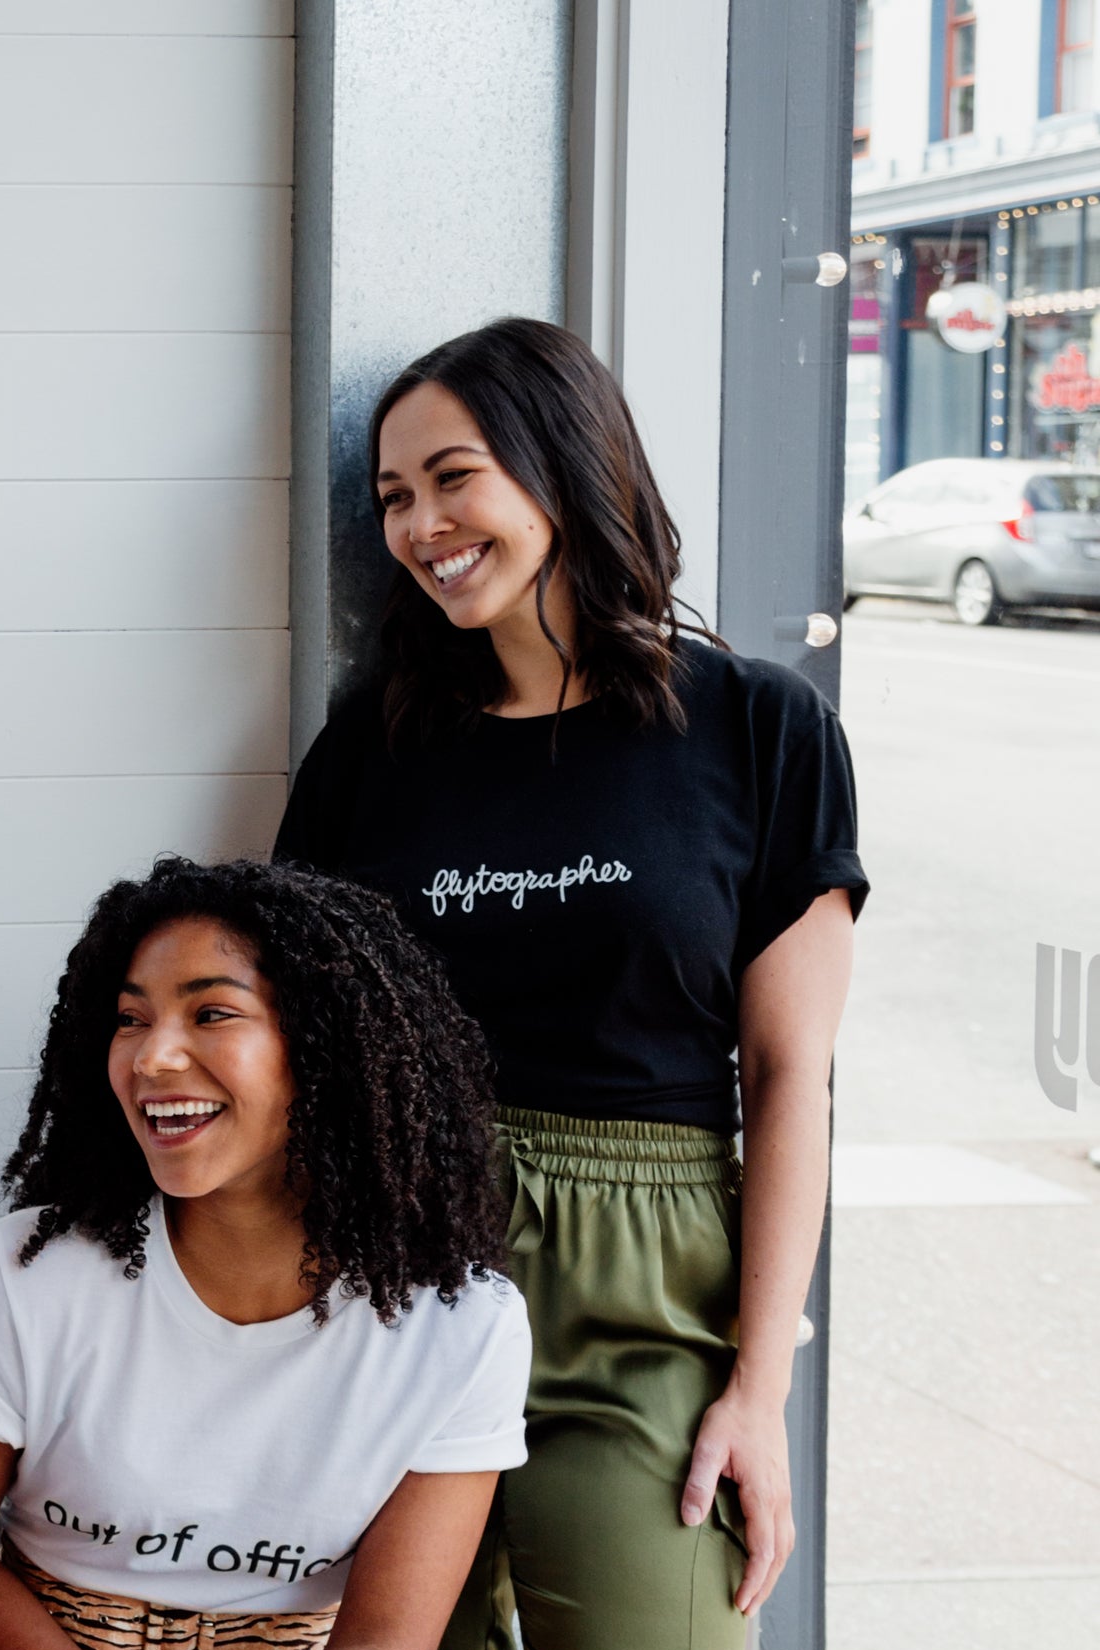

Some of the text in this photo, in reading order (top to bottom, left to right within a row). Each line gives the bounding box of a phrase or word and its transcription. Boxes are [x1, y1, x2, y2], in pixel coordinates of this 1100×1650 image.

[421, 854, 633, 917] flytographer
[43, 1499, 334, 1584] Out of offic
